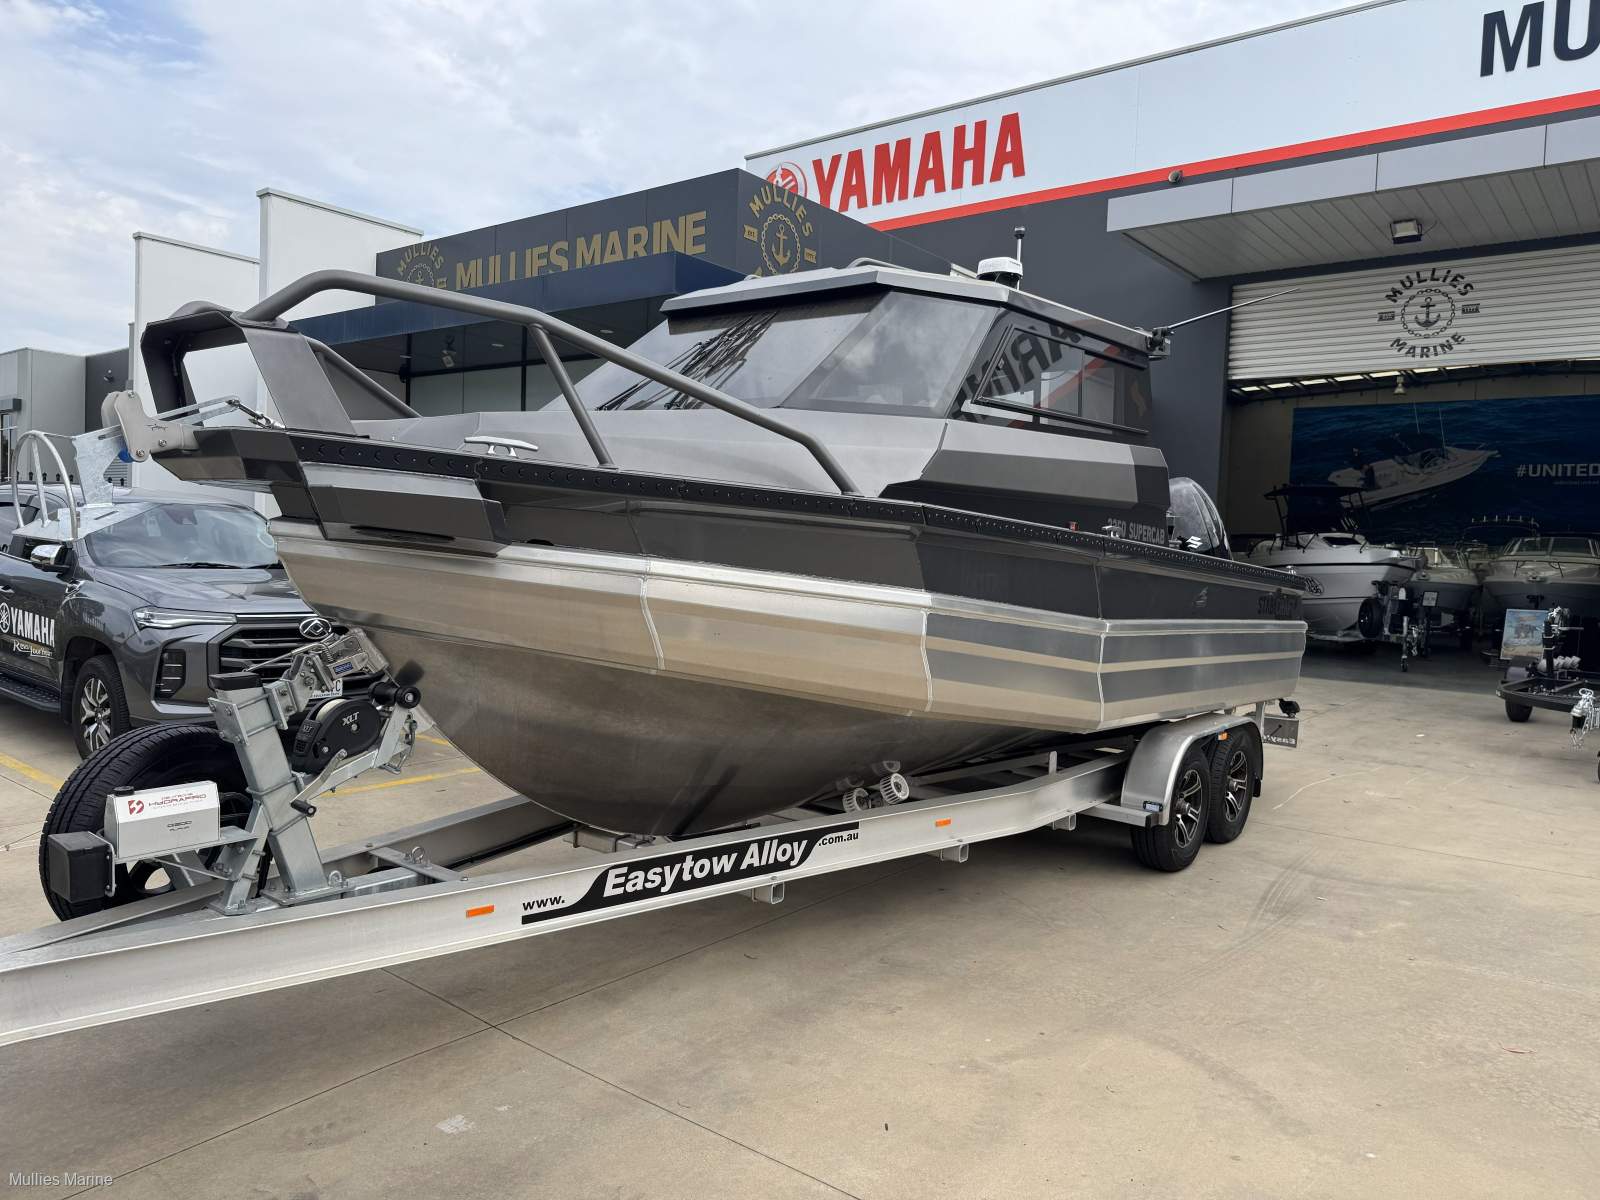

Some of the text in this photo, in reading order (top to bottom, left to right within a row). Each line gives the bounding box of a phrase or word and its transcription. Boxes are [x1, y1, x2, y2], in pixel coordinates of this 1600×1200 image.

[812, 112, 1025, 212] YAMAHA
[749, 180, 814, 237] MULLIES
[576, 210, 707, 269] MARINE
[1385, 268, 1475, 303] MULLIES
[1390, 331, 1466, 358] MARINE
[1129, 522, 1165, 545] SUPERCAB
[11, 606, 55, 648] YAMAHA
[342, 711, 360, 727] XLT
[522, 832, 859, 911] www. Easytow Alloy .com.au
